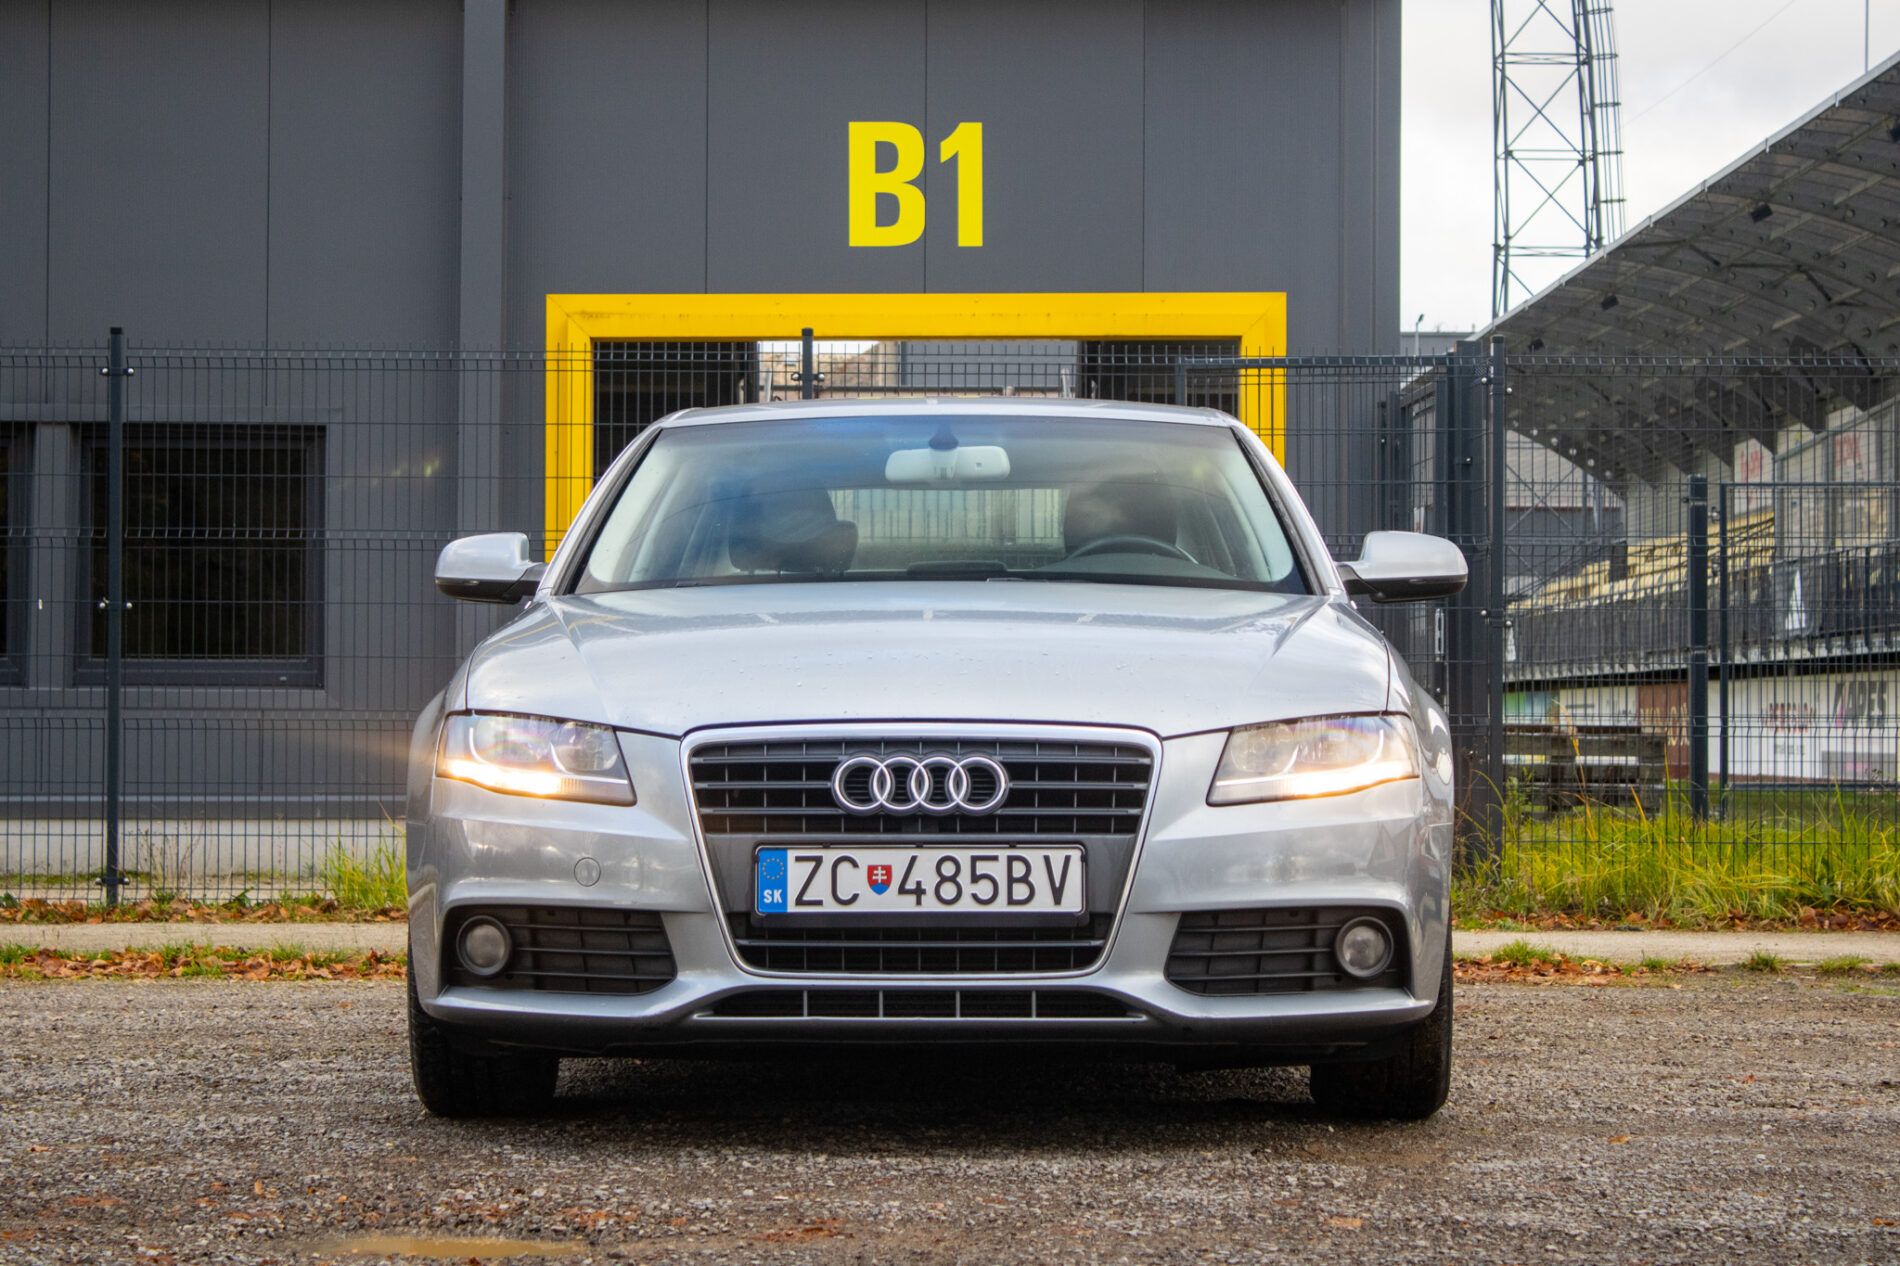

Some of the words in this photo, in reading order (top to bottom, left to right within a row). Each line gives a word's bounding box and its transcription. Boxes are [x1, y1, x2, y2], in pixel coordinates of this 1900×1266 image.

[848, 121, 984, 247] B1
[763, 888, 783, 904] SK
[794, 855, 860, 907] ZC
[897, 855, 1072, 907] 485BV
